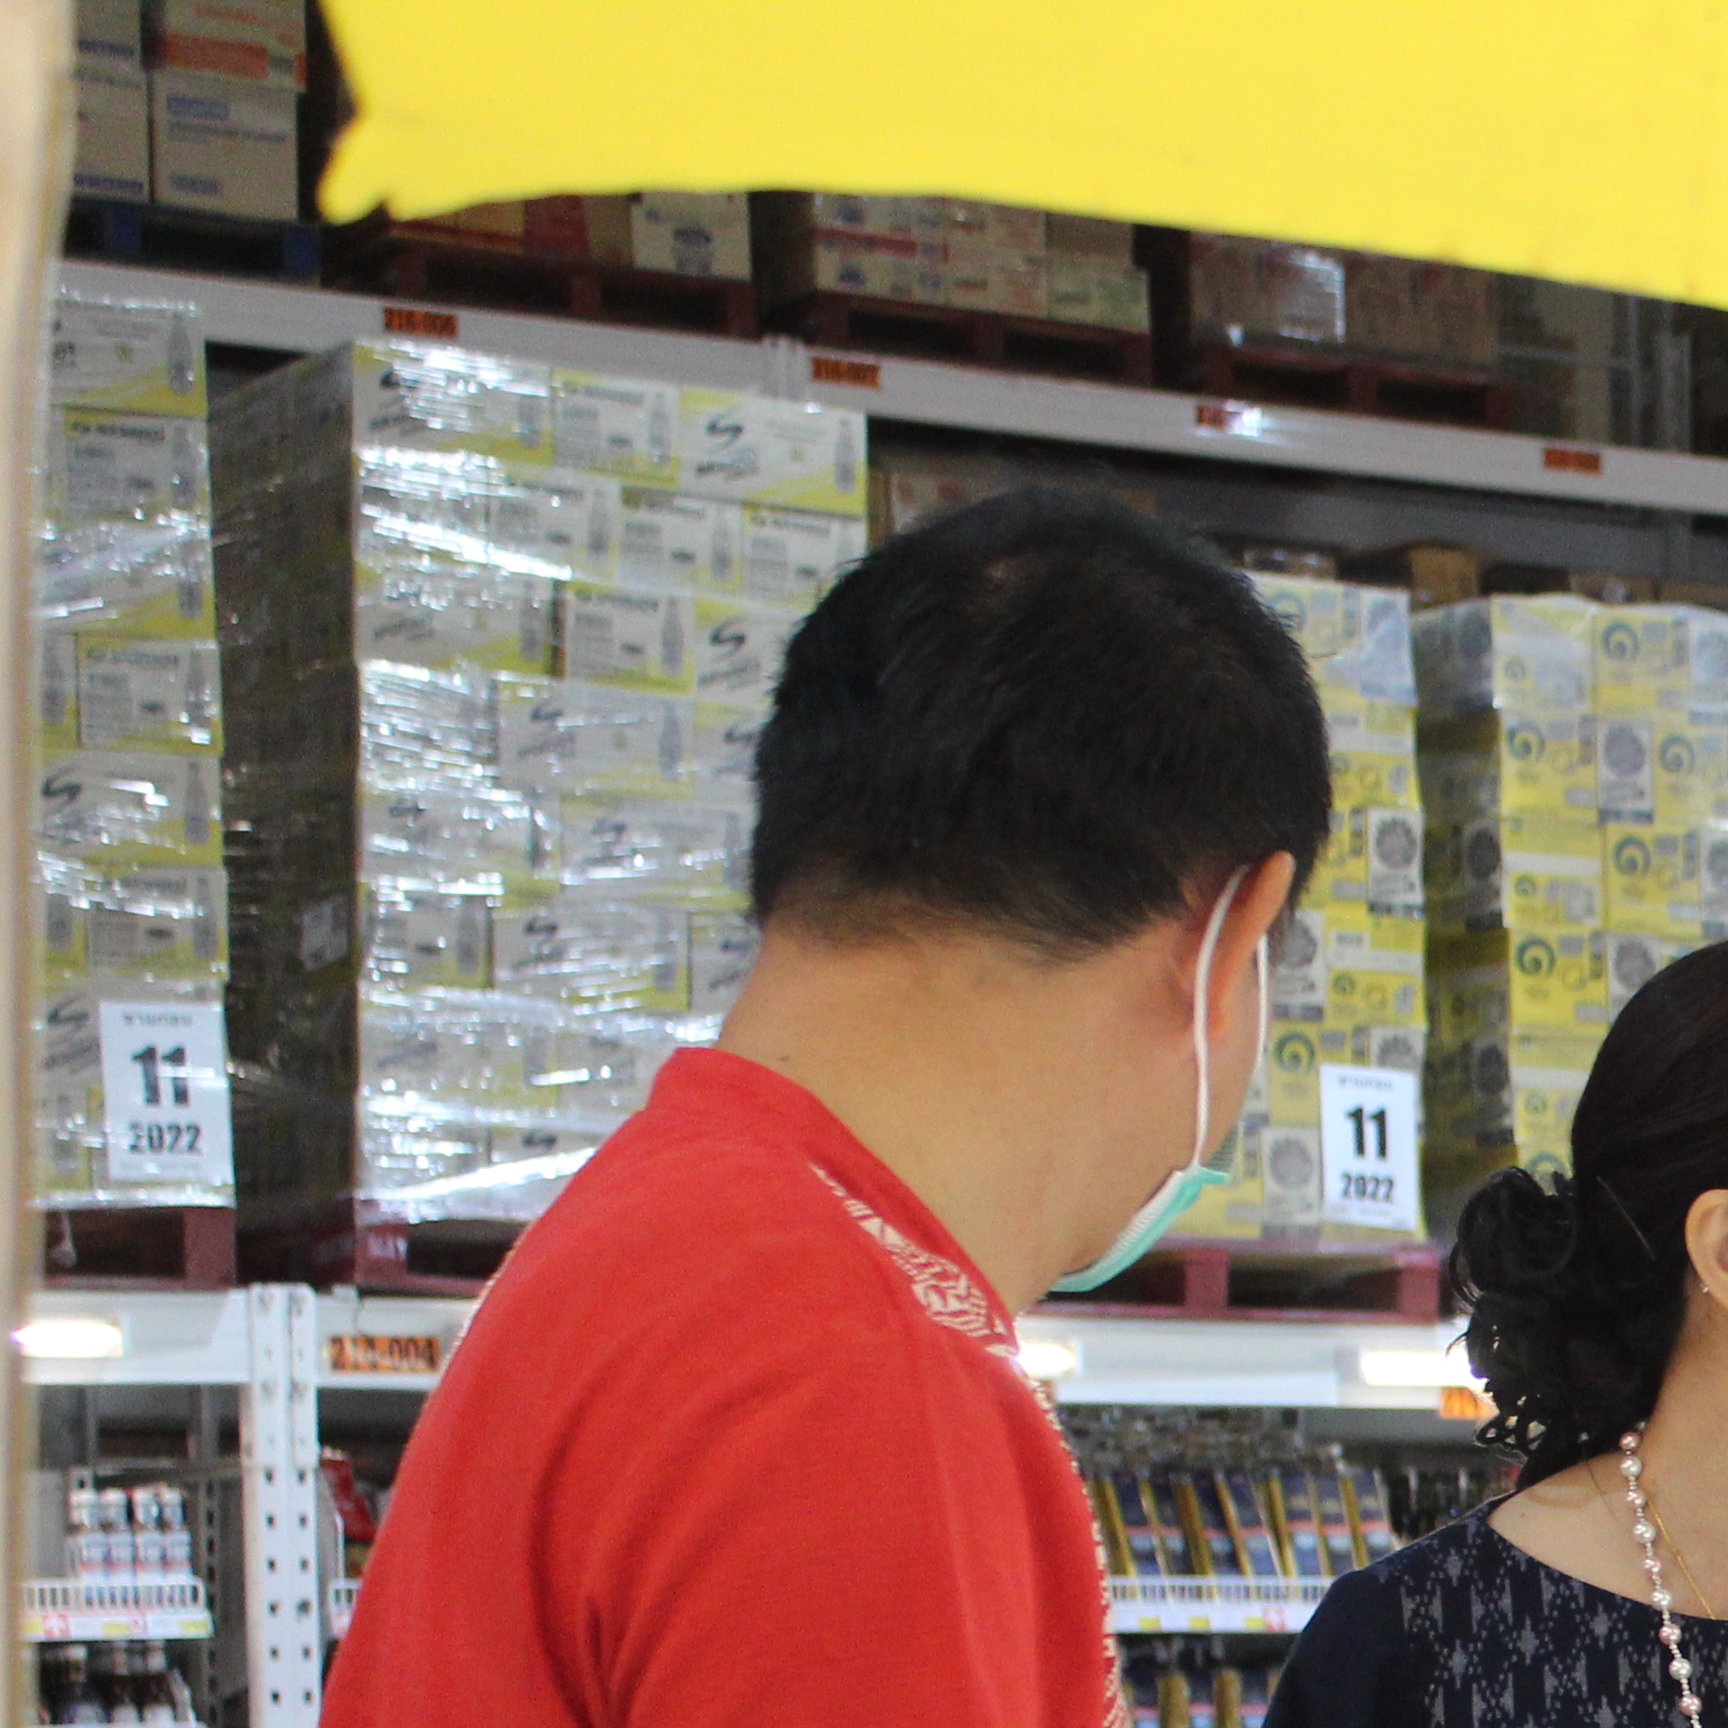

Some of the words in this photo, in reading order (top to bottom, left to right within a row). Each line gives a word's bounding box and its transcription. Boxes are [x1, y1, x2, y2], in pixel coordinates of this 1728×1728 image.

[131, 1044, 190, 1107] 11
[129, 1120, 203, 1155] 2022
[1345, 1104, 1389, 1160] 11
[1340, 1172, 1395, 1203] 2022
